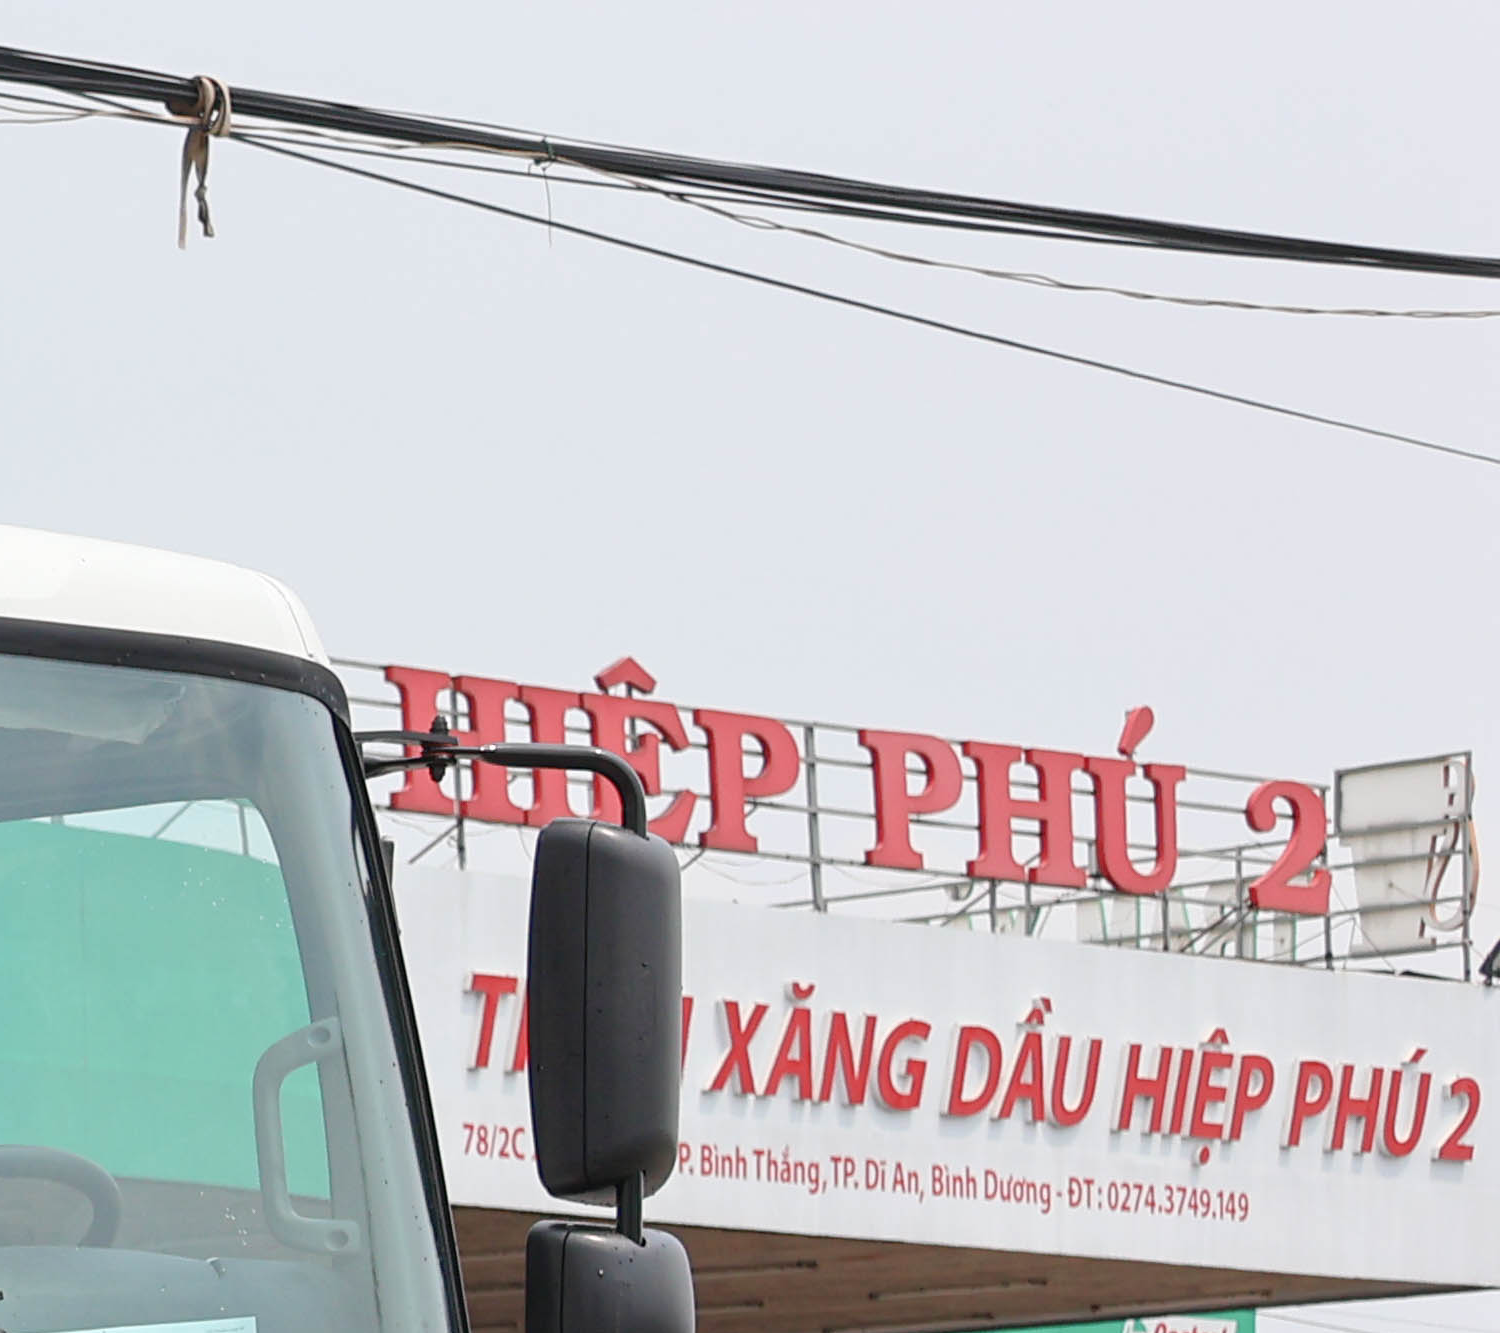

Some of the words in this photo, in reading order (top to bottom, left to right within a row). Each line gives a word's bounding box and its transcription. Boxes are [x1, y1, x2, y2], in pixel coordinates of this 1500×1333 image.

[858, 705, 1186, 895] PHÚ
[1245, 780, 1333, 915] 2
[705, 982, 931, 1110] XĂNG
[942, 997, 1102, 1127] DẦU
[1111, 1028, 1275, 1166] HIỆP
[1281, 1047, 1432, 1158] PHÚ
[1434, 1075, 1481, 1162] 2
[462, 1123, 526, 1160] 78/2C
[701, 1145, 747, 1179] Bình
[830, 1156, 859, 1190] TP.
[893, 1158, 925, 1203] An,
[931, 1164, 978, 1200] Bình
[983, 1168, 1052, 1213] Dương
[1107, 1181, 1250, 1222] 0274.3749.149
